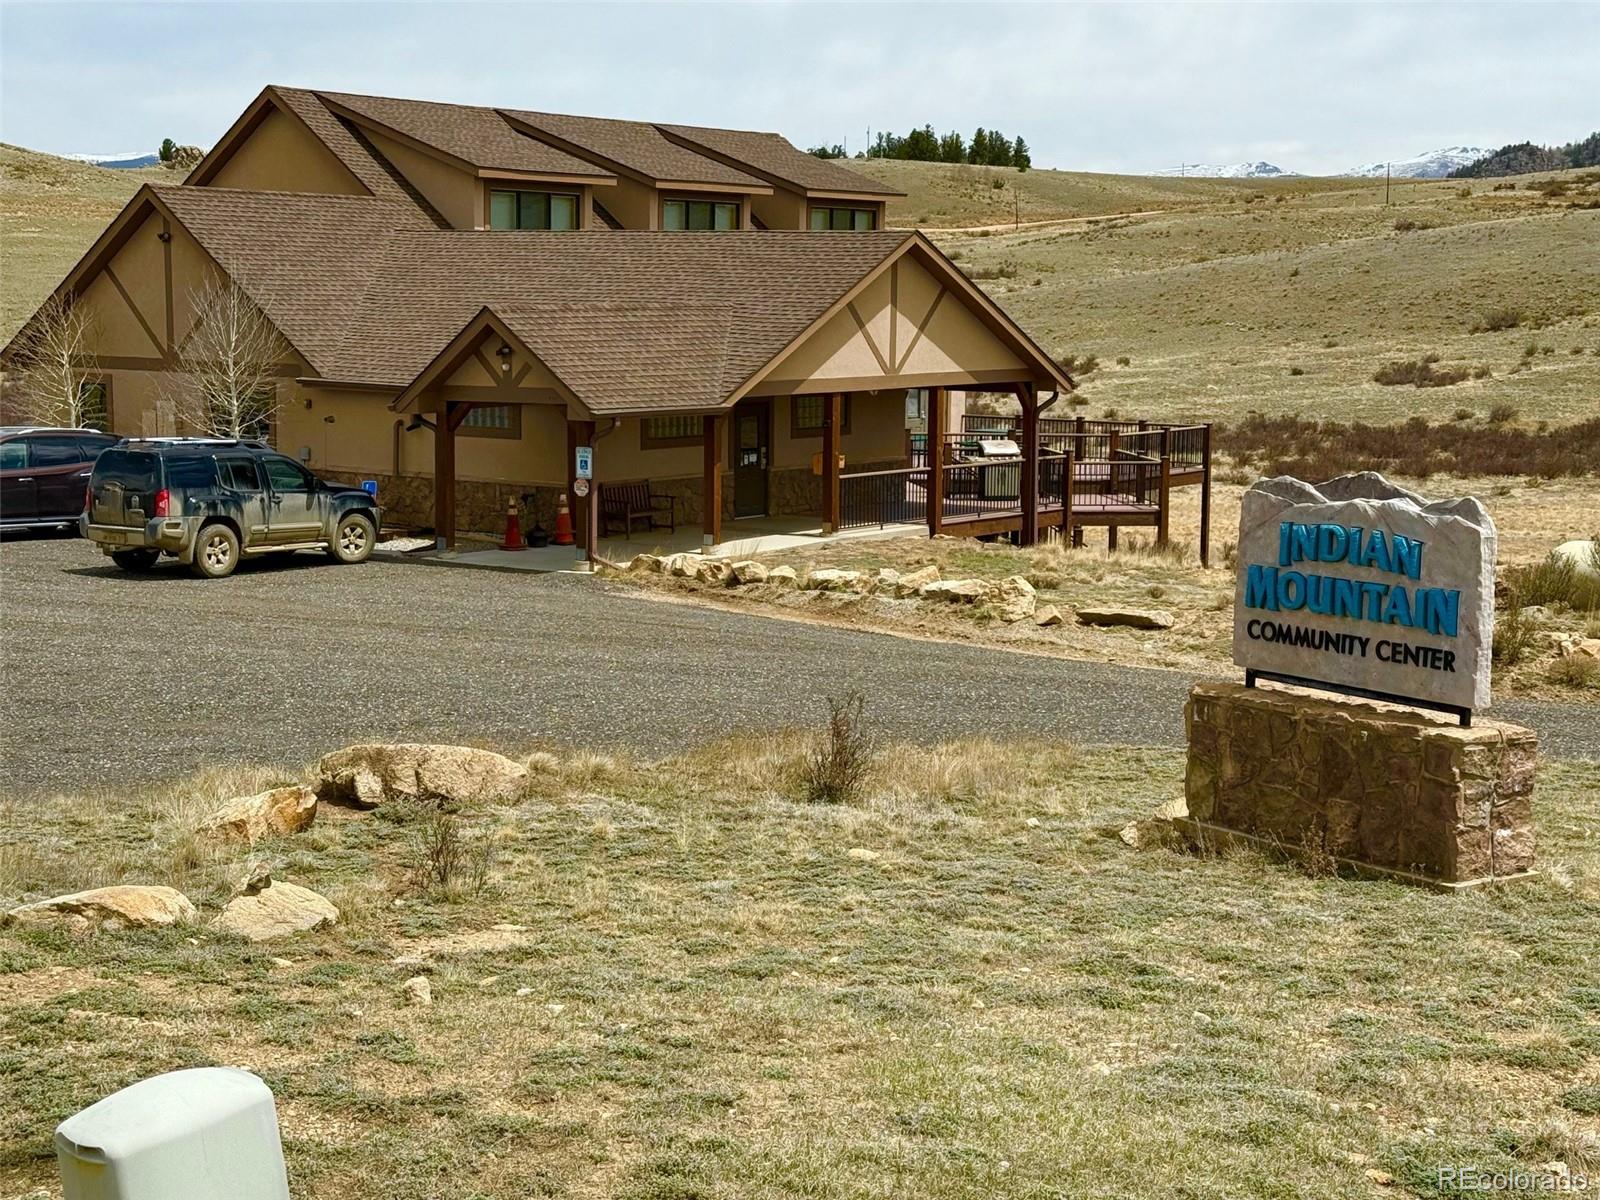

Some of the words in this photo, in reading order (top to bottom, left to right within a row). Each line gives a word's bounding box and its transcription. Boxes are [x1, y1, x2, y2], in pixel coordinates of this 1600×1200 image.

[1278, 521, 1423, 580] INDIAN
[1244, 564, 1460, 637] MOUNTAIN
[1247, 619, 1370, 657] COMMUNITY
[1376, 640, 1456, 673] CENTER
